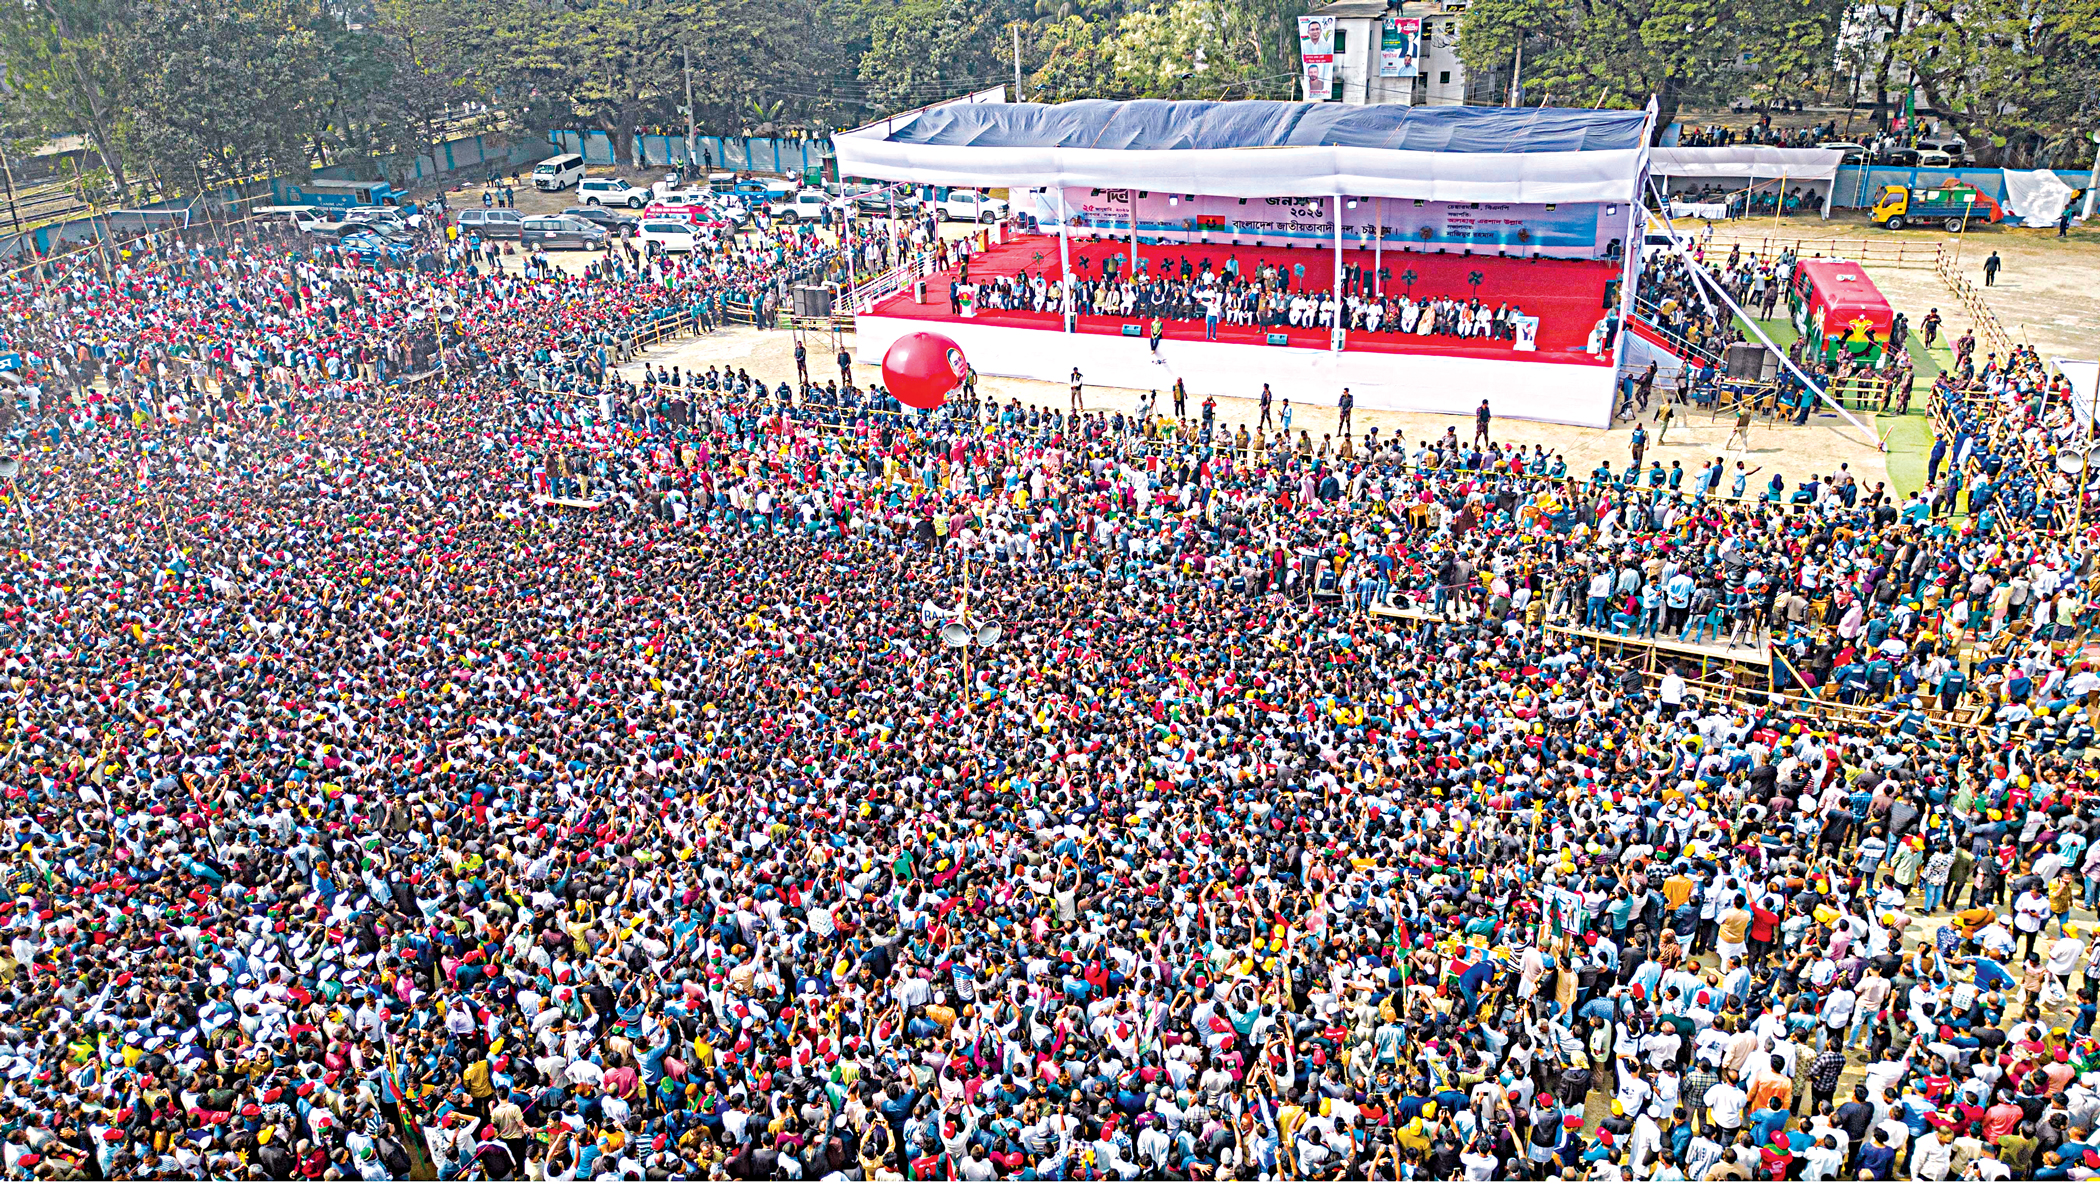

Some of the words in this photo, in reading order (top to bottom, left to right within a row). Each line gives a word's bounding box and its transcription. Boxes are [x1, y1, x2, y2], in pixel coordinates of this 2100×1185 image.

[1266, 196, 1324, 207] জনসা
[1082, 204, 1094, 212] ২৫
[1290, 208, 1323, 218] ২০২৬
[1232, 220, 1274, 230] বাংলাদেশ
[1276, 219, 1334, 233] জাতীয়তাবাদী
